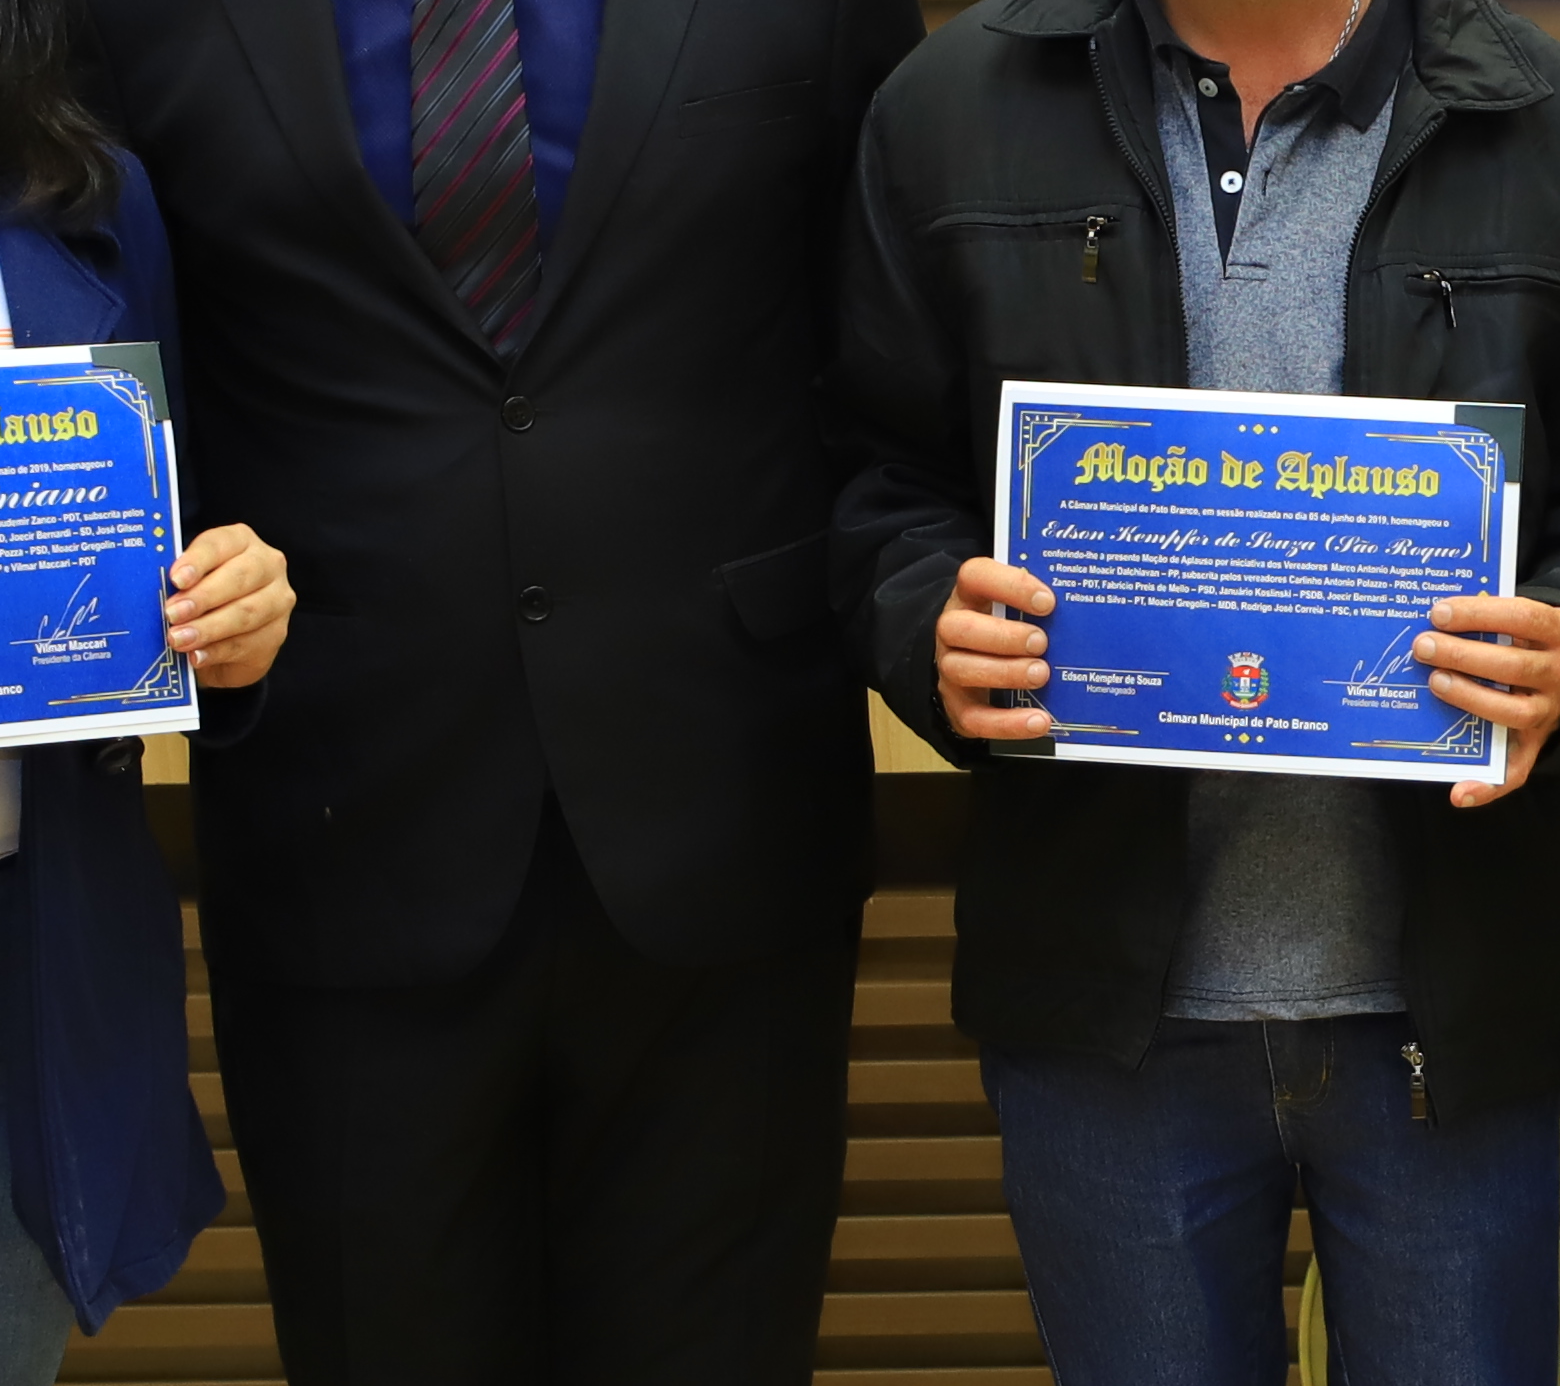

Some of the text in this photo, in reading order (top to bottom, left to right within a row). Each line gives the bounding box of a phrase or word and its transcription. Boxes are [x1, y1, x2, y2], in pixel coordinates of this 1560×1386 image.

[28, 462, 52, 473] 2019,
[51, 460, 106, 471] homenageou
[1073, 441, 1440, 499] Moção de Aplauso
[1067, 499, 1098, 510] Câmara
[1098, 501, 1138, 513] Municipal
[1149, 503, 1169, 514] Pato
[1169, 504, 1200, 516] Branco,
[1215, 507, 1245, 517] sessão
[1244, 509, 1282, 519] realizada
[1293, 510, 1308, 521] dia
[1330, 512, 1355, 524] junho
[1366, 513, 1389, 525] 2019,
[1389, 515, 1442, 528] homenageou
[34, 637, 107, 654] Vilmar Maccari
[1061, 669, 1162, 686] Edson Kempfer de Souza
[1346, 684, 1416, 699] Vilmar Maccari
[1158, 710, 1328, 731] Câmara Municipal de Pato Branco
